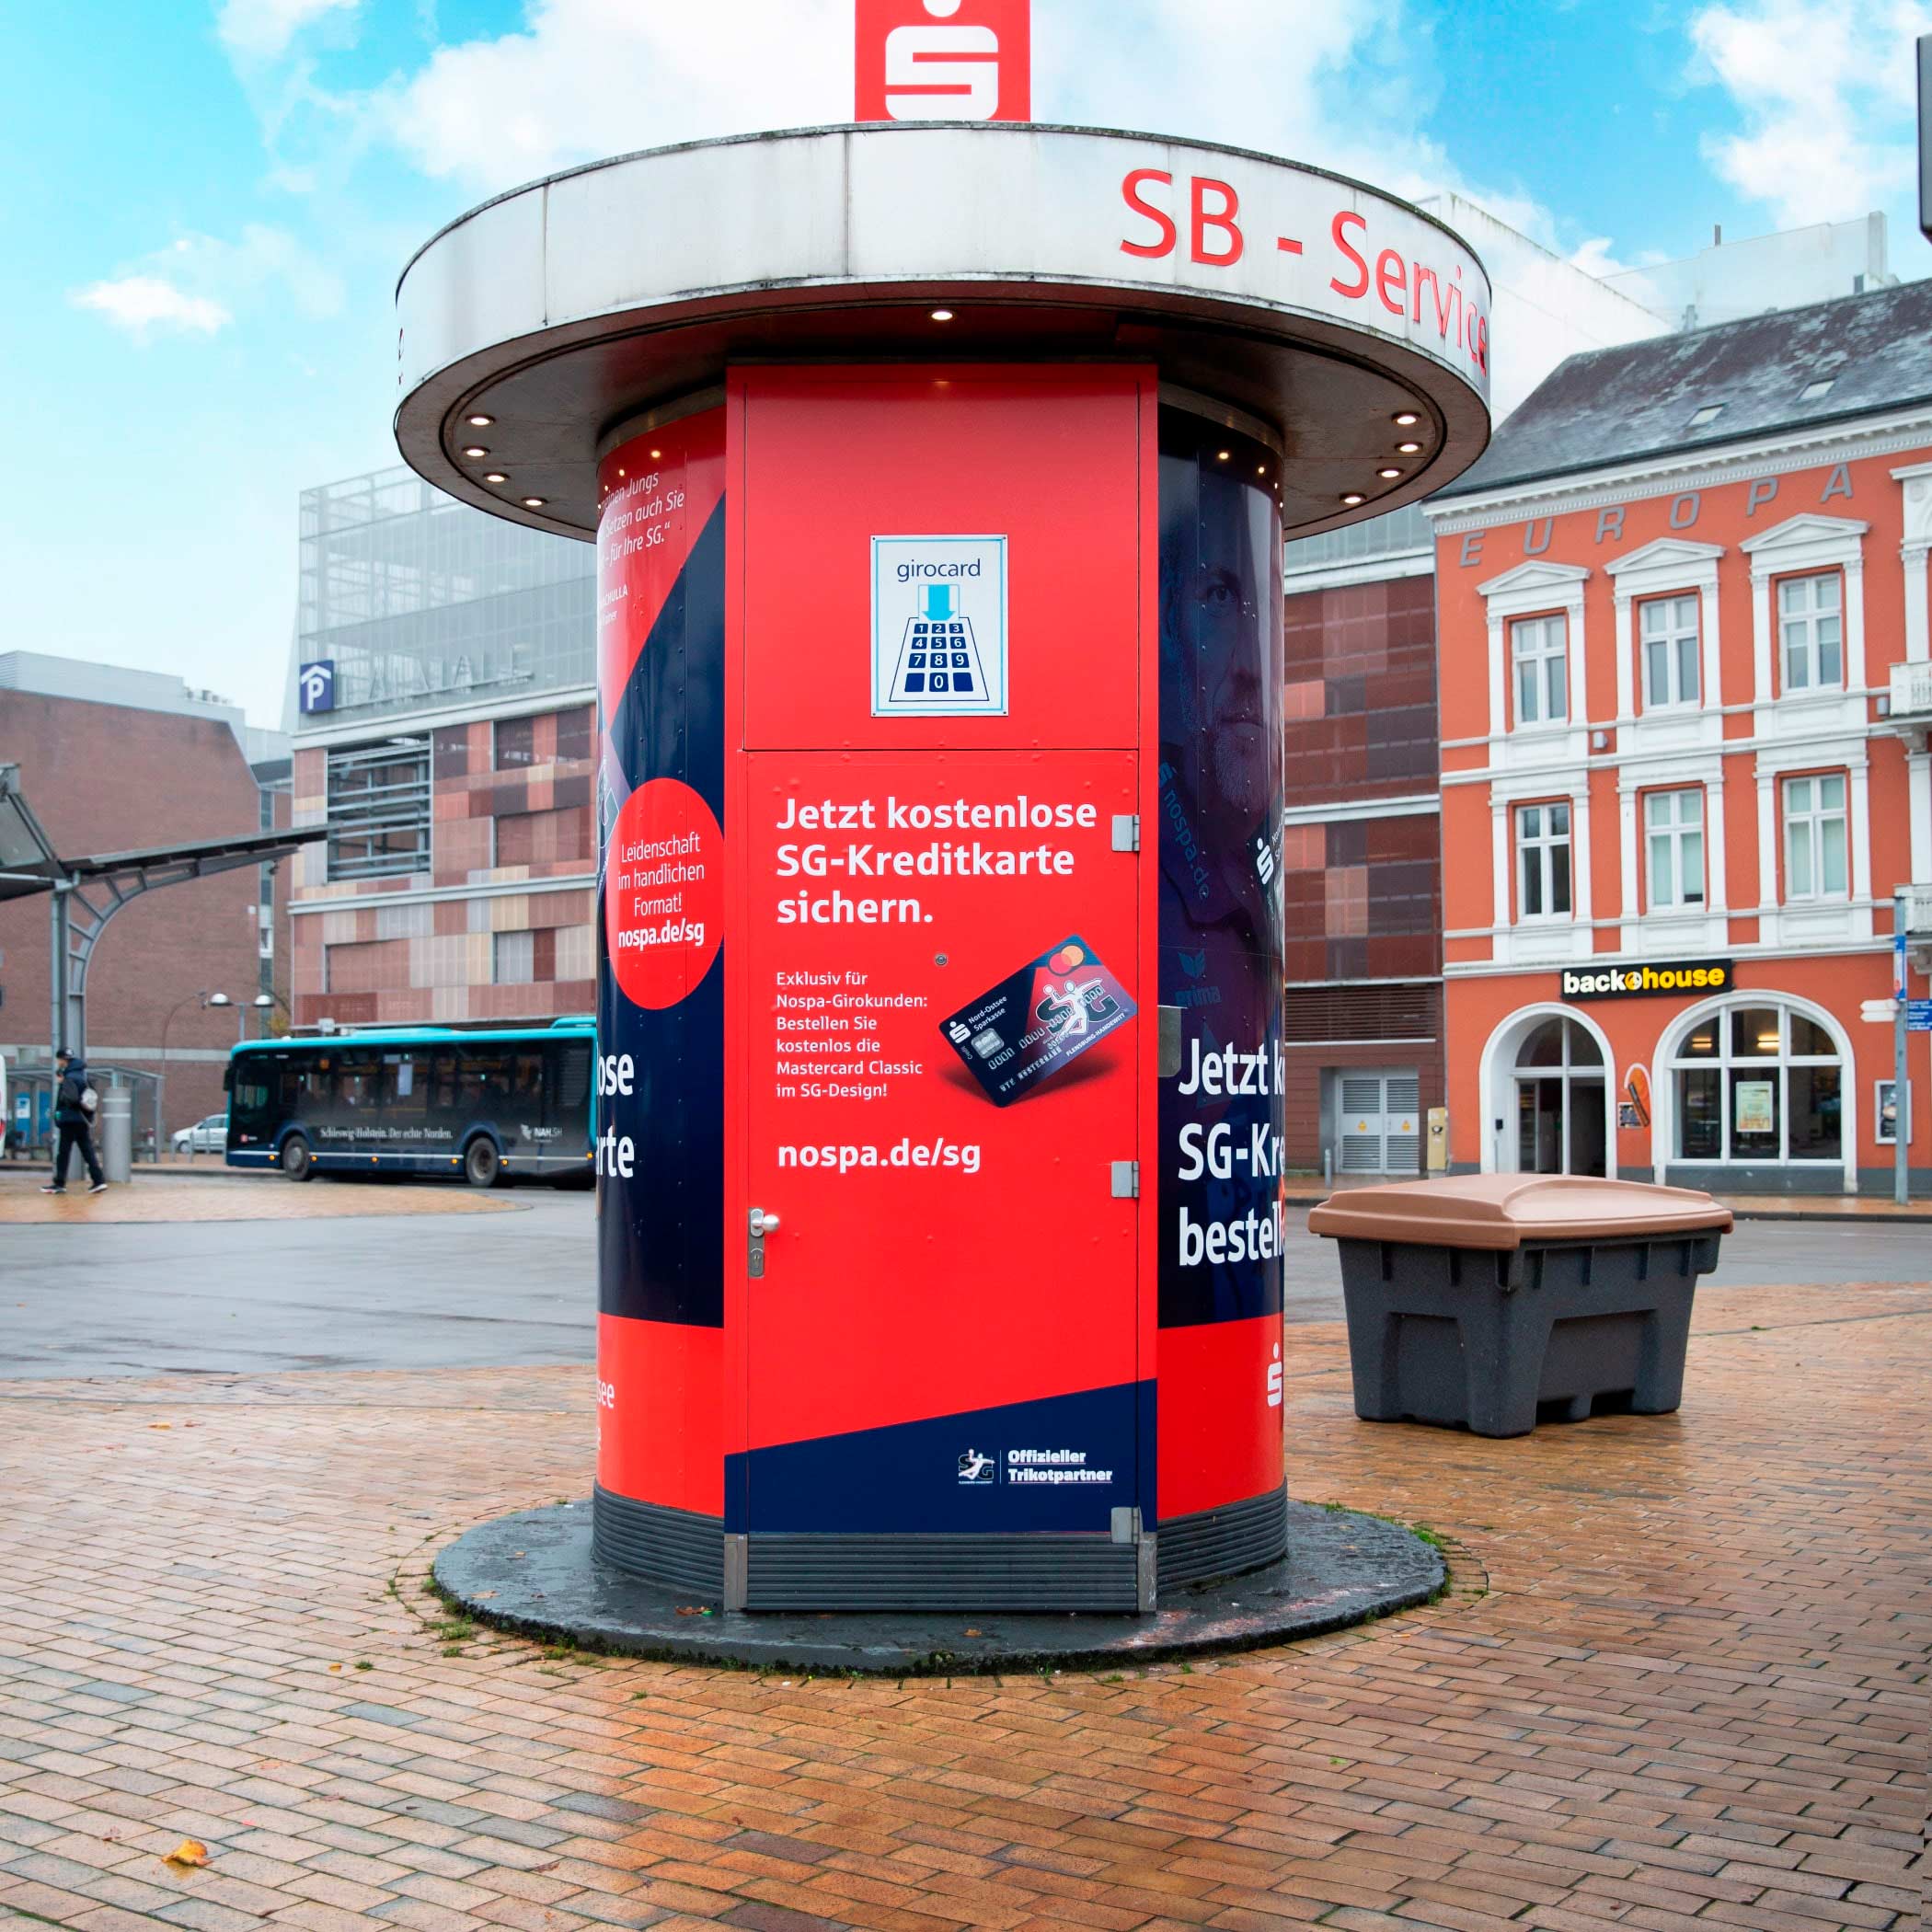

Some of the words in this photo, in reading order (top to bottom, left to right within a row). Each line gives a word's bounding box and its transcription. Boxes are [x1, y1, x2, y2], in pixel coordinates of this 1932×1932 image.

[1120, 168, 1243, 266] SB
[1330, 212, 1487, 377] Service
[627, 473, 659, 498] Jungs
[636, 496, 662, 523] auch
[666, 491, 685, 512] Sie
[1459, 463, 1854, 567] EUROPA
[610, 542, 623, 568] für
[624, 535, 643, 556] Ihre
[897, 558, 982, 582] girocard
[915, 638, 923, 647] 4
[935, 638, 942, 647] 5
[954, 638, 961, 647] 6
[914, 655, 922, 666] 7
[935, 655, 943, 666] 8
[956, 655, 964, 666] 9
[934, 675, 944, 688] 0
[776, 798, 876, 829] Jetzt
[888, 796, 1098, 828] kostenlose
[621, 832, 701, 864] Leidenschaft
[1164, 788, 1210, 900] nospa.de
[776, 842, 1075, 877] SG-Kreditkarte
[618, 869, 631, 891] im
[634, 863, 705, 888] handlichen
[635, 892, 682, 916] Format!
[776, 891, 934, 924] sichern.
[618, 918, 705, 951] nospa.de/sg
[776, 972, 841, 985] Exklusiv
[845, 972, 868, 985] für
[776, 994, 927, 1010] Nospa-Girokunden:
[968, 995, 1007, 1025] Nord-Ostsee
[776, 1017, 848, 1030] Bestellen
[854, 1017, 877, 1030] Sie
[973, 1007, 1006, 1032] Sparkasse
[776, 1039, 851, 1052] kostenlos
[857, 1039, 880, 1052] die
[1065, 1012, 1126, 1057] FLENSBURG-HANDEWITT
[776, 1061, 863, 1075] Mastercard
[868, 1061, 923, 1075] Classic
[1178, 1038, 1268, 1096] Jetzt
[776, 1083, 795, 1097] im
[800, 1083, 887, 1100] SG-Design!
[320, 1126, 387, 1141] Schleswig-Holstein.
[388, 1127, 402, 1138] Der
[403, 1127, 422, 1138] echte
[424, 1127, 454, 1139] Norden.
[778, 1137, 981, 1174] nospa.de/sg
[1007, 1450, 1086, 1464] Offizieller
[1007, 1468, 1113, 1485] Trikotpartner
